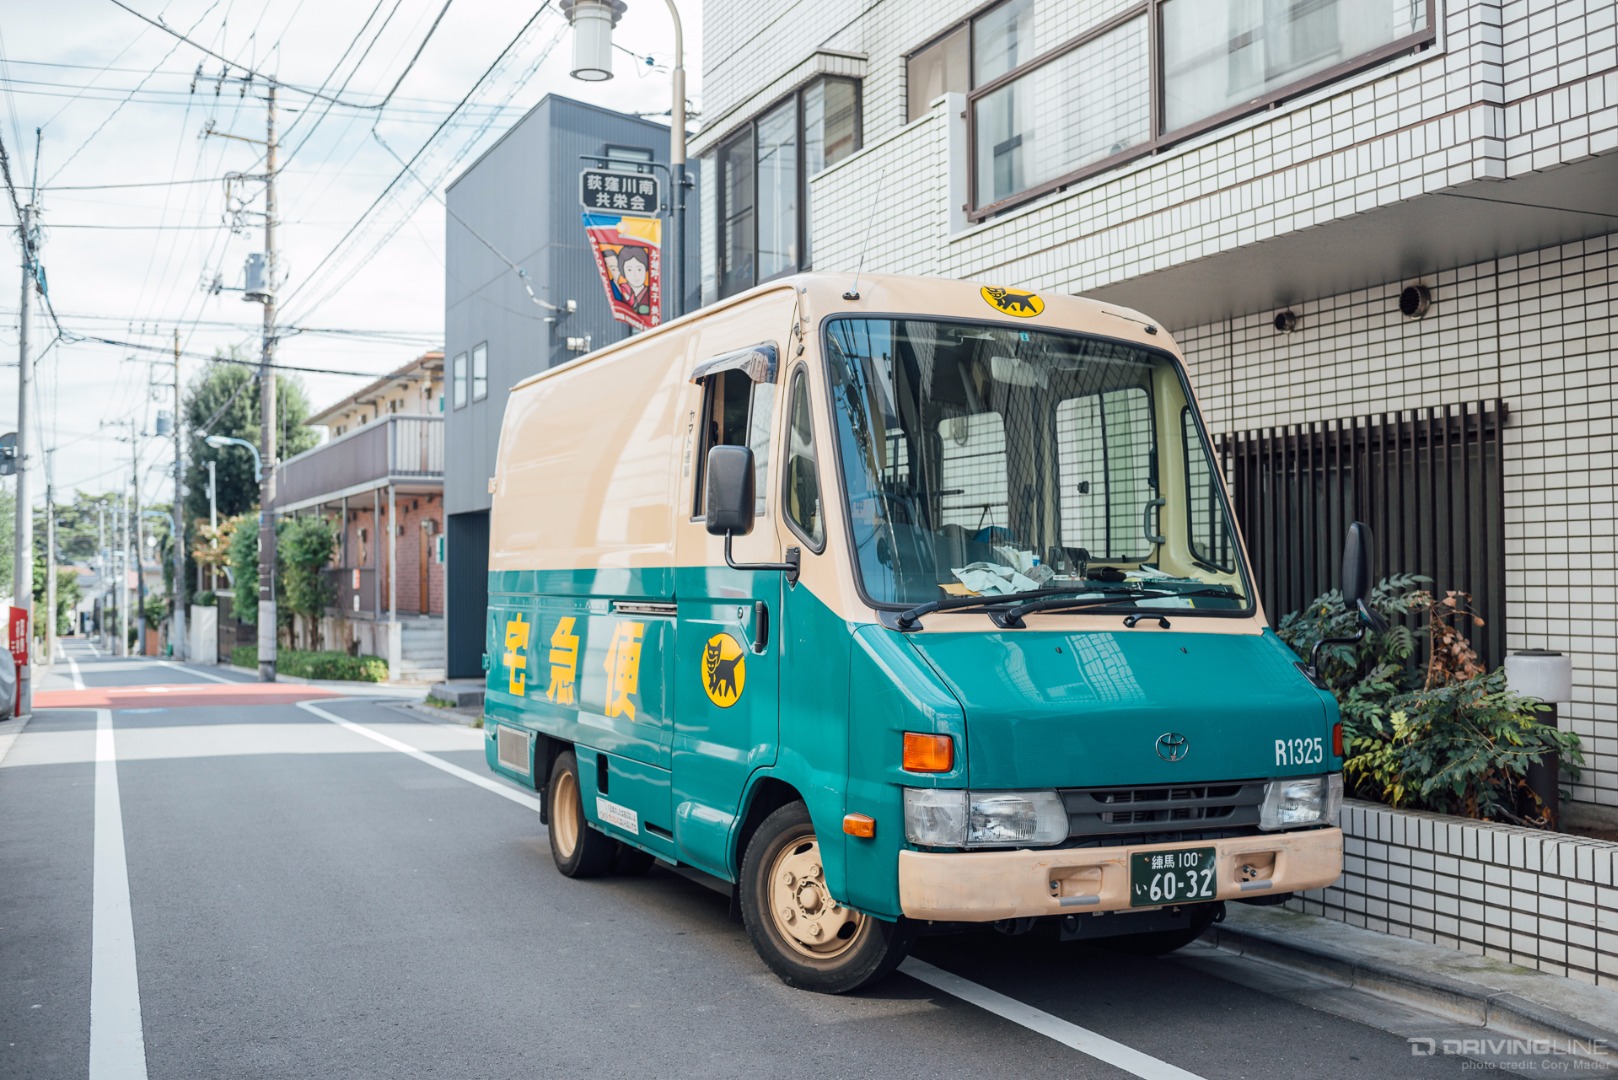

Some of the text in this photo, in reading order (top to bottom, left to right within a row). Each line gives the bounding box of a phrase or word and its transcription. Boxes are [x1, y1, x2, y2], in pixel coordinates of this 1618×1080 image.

[587, 174, 654, 196] 荻窪川南
[596, 192, 645, 211] 共栄会
[503, 612, 645, 722] 宅急便
[1275, 737, 1323, 767] R1325
[1151, 851, 1198, 870] 練馬 100
[1135, 868, 1213, 902] い 60-32
